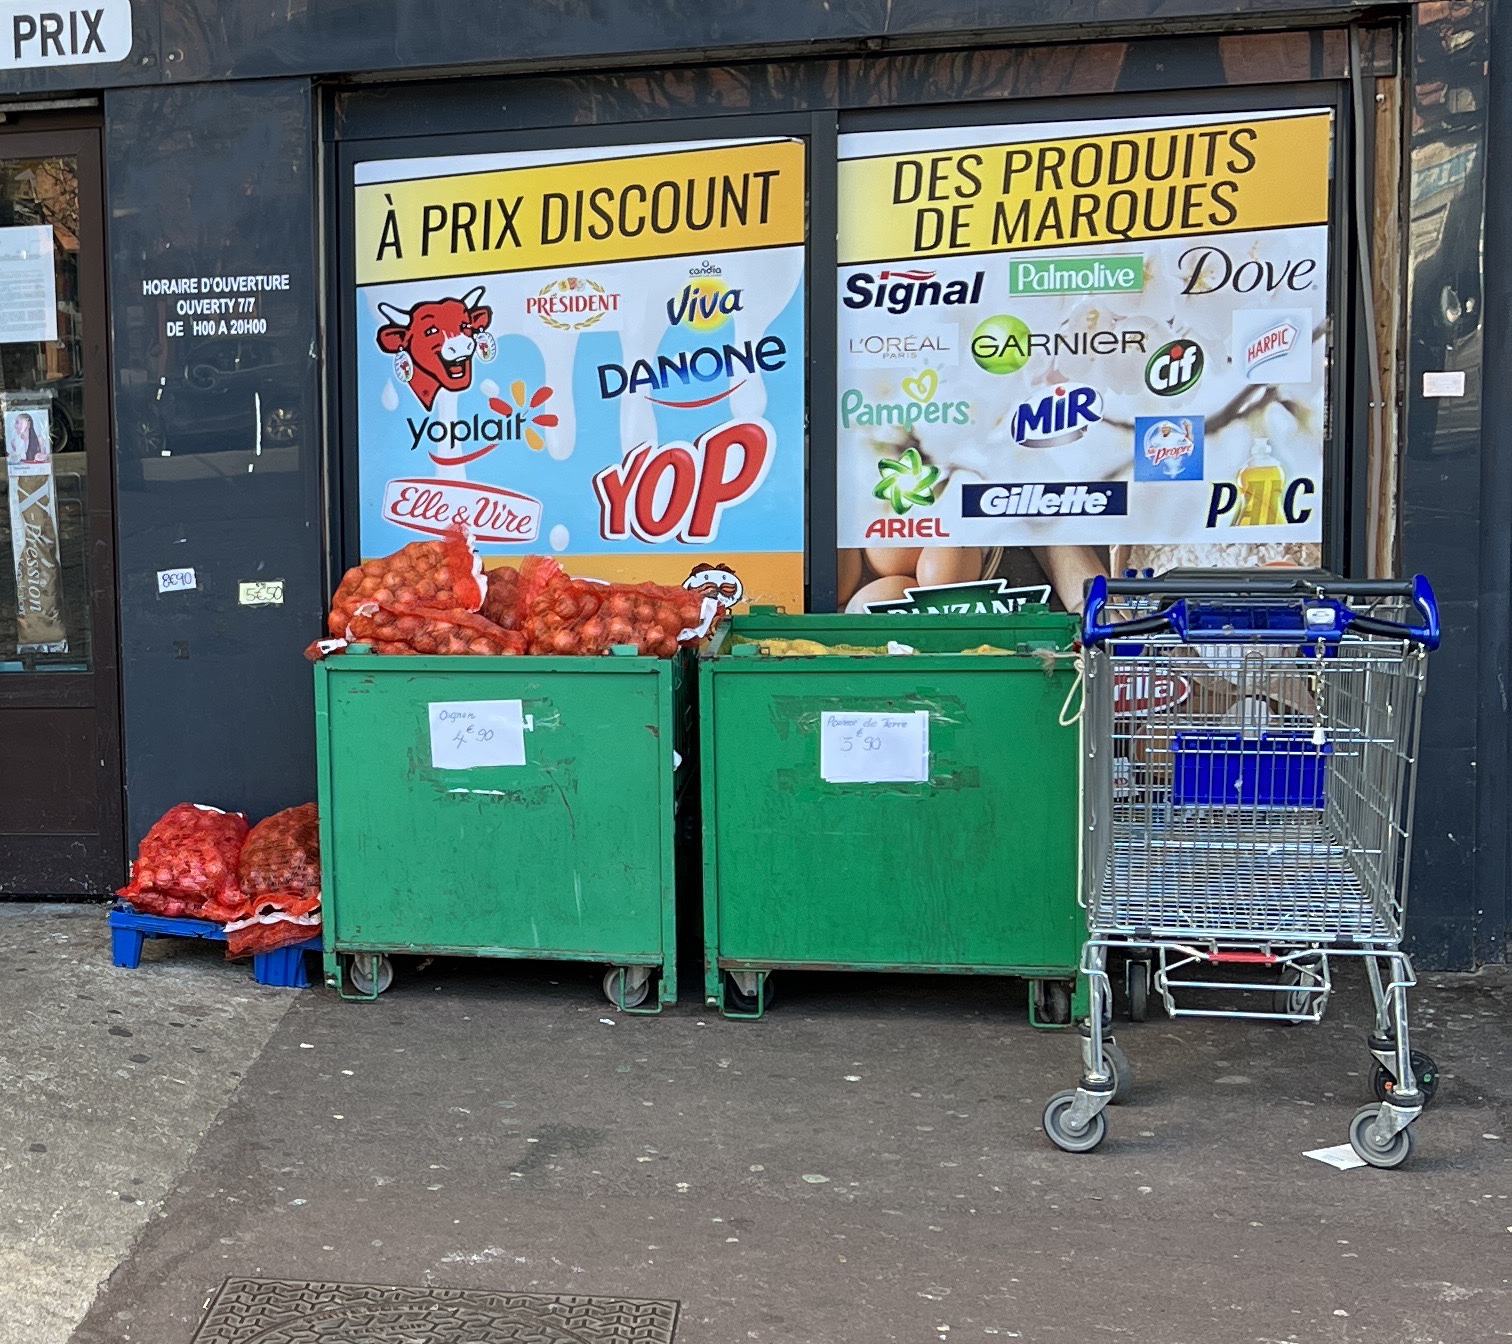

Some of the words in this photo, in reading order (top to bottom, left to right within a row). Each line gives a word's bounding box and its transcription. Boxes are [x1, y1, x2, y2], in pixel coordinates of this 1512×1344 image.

[13, 8, 107, 59] PRIX
[893, 154, 984, 205] DES
[1002, 127, 1258, 196] PRODUITS
[376, 193, 403, 262] À
[421, 195, 525, 258] PRIX
[540, 170, 781, 248] DISCOUNT
[913, 203, 974, 253] DE
[991, 179, 1240, 246] MARQUES
[143, 277, 198, 296] HORAIRE
[201, 274, 290, 293] D'OUVERTURE
[1017, 260, 1136, 292] Palmolive
[1178, 246, 1317, 295] Dove
[176, 298, 236, 316] OUVERTY
[238, 296, 256, 314] 7/7
[526, 291, 621, 317] PRÉSIDENT
[666, 285, 745, 328] Viva
[843, 271, 986, 315] Signal
[166, 321, 185, 338] DE
[218, 319, 228, 336] A
[230, 317, 267, 336] 20H00
[850, 334, 951, 354] L'ORÉAL
[1247, 327, 1289, 363] HARPIC
[882, 352, 918, 360] PARIS
[1149, 343, 1198, 391] Cif
[842, 388, 970, 432] Pampers
[407, 413, 528, 452] Yoplait
[598, 420, 772, 539] YOP
[979, 484, 1109, 516] Gillette
[390, 486, 450, 522] Elle
[474, 494, 533, 535] Vire
[865, 517, 951, 539] ARIEL
